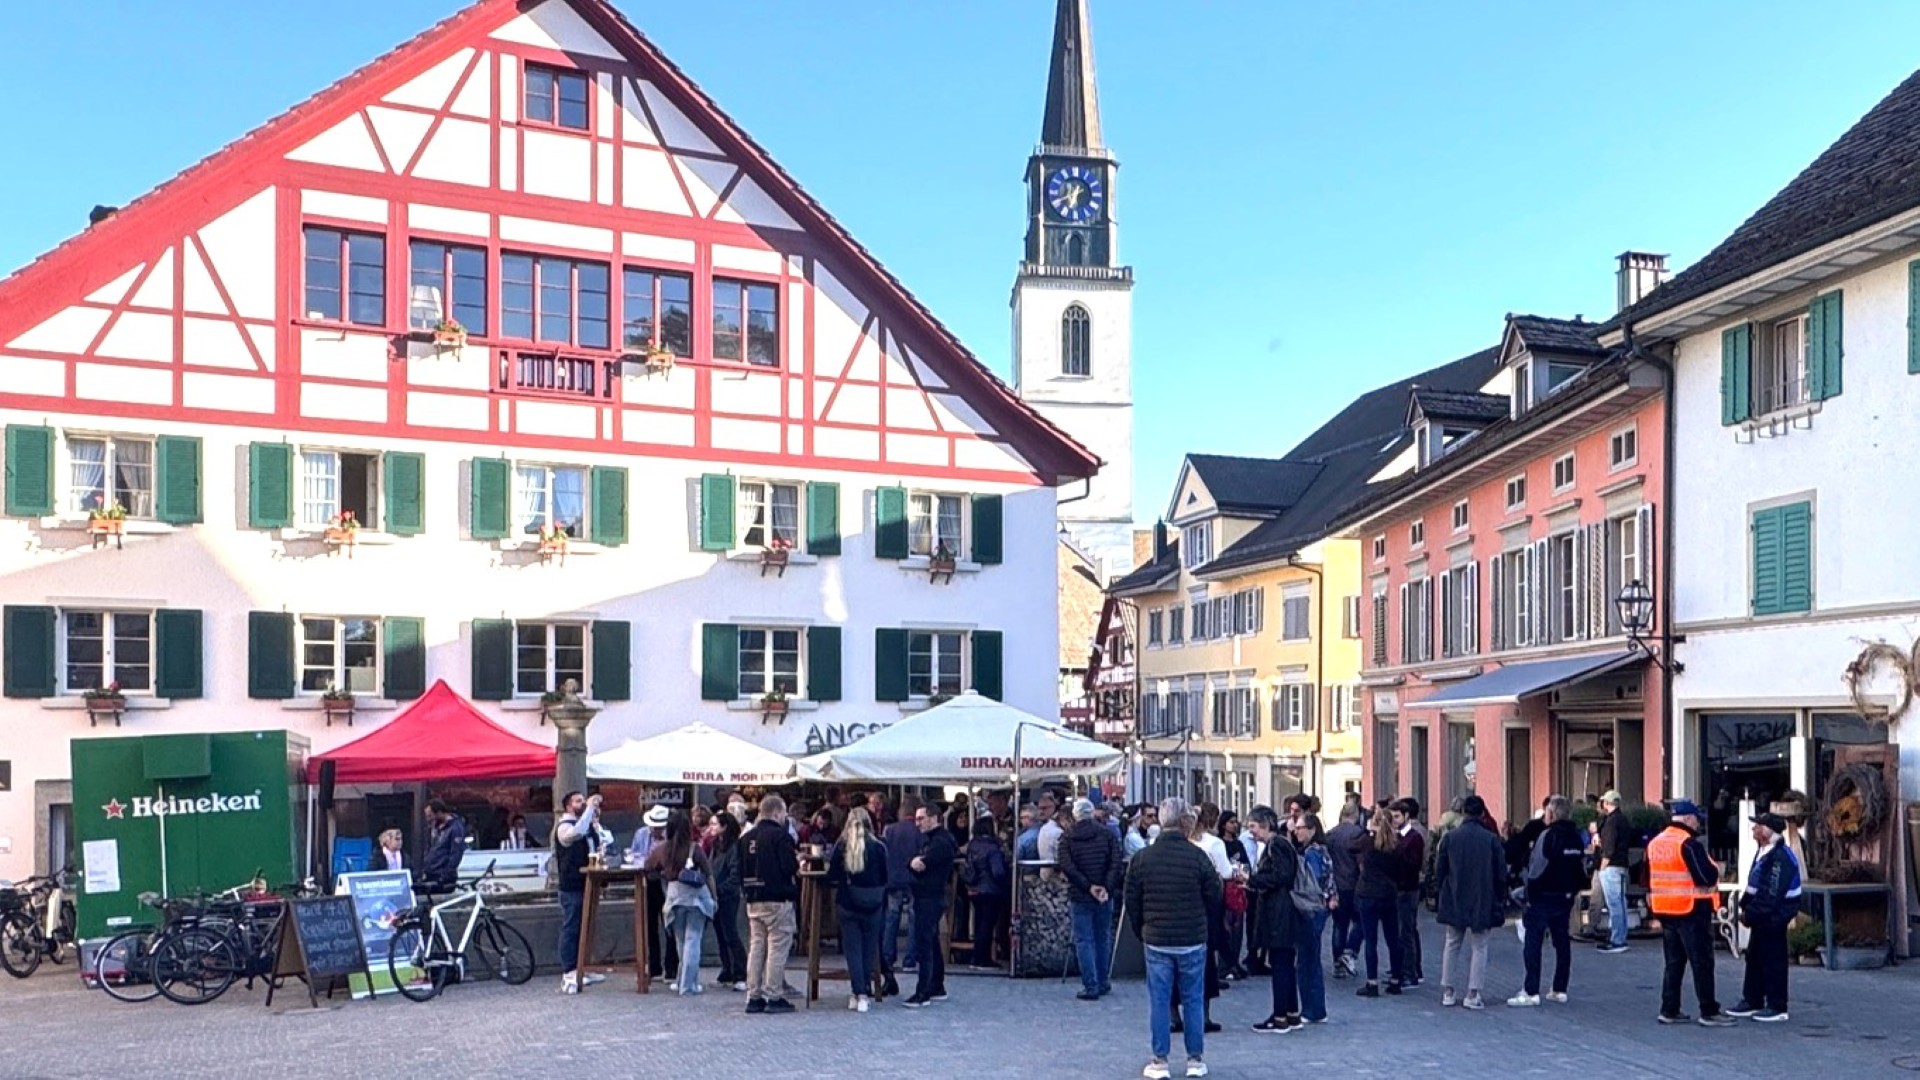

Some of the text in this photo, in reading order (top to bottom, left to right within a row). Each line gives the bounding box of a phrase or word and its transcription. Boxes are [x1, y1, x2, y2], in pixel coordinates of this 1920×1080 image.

[805, 722, 894, 747] ANG
[961, 756, 1097, 769] BIRRA MORETTI
[682, 771, 724, 781] BIRRA
[132, 792, 262, 817] Heineken
